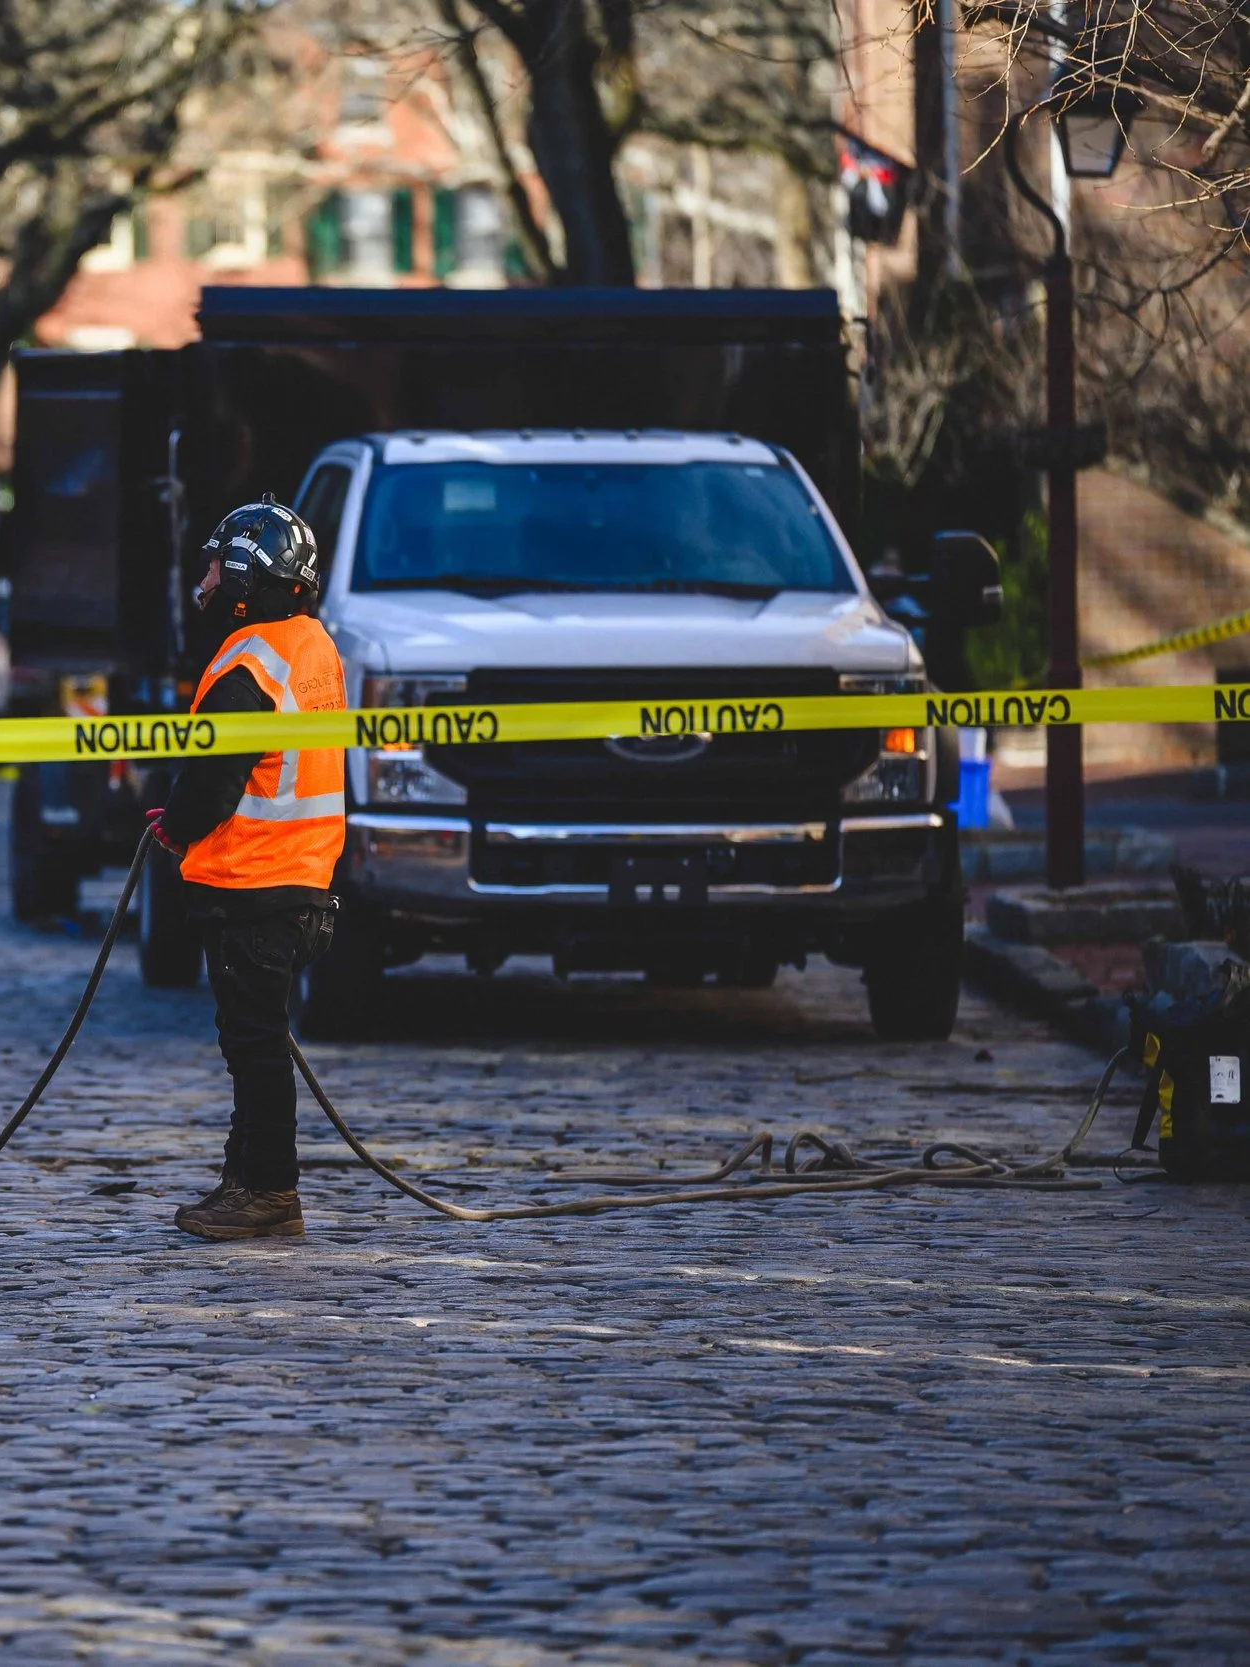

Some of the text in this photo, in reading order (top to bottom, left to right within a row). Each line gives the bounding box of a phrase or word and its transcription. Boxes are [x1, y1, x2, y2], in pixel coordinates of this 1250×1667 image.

[640, 703, 784, 734] CAUTION
[926, 694, 1071, 726] CAUTION
[76, 719, 215, 753] CAUTION
[355, 711, 498, 747] CAUTION
